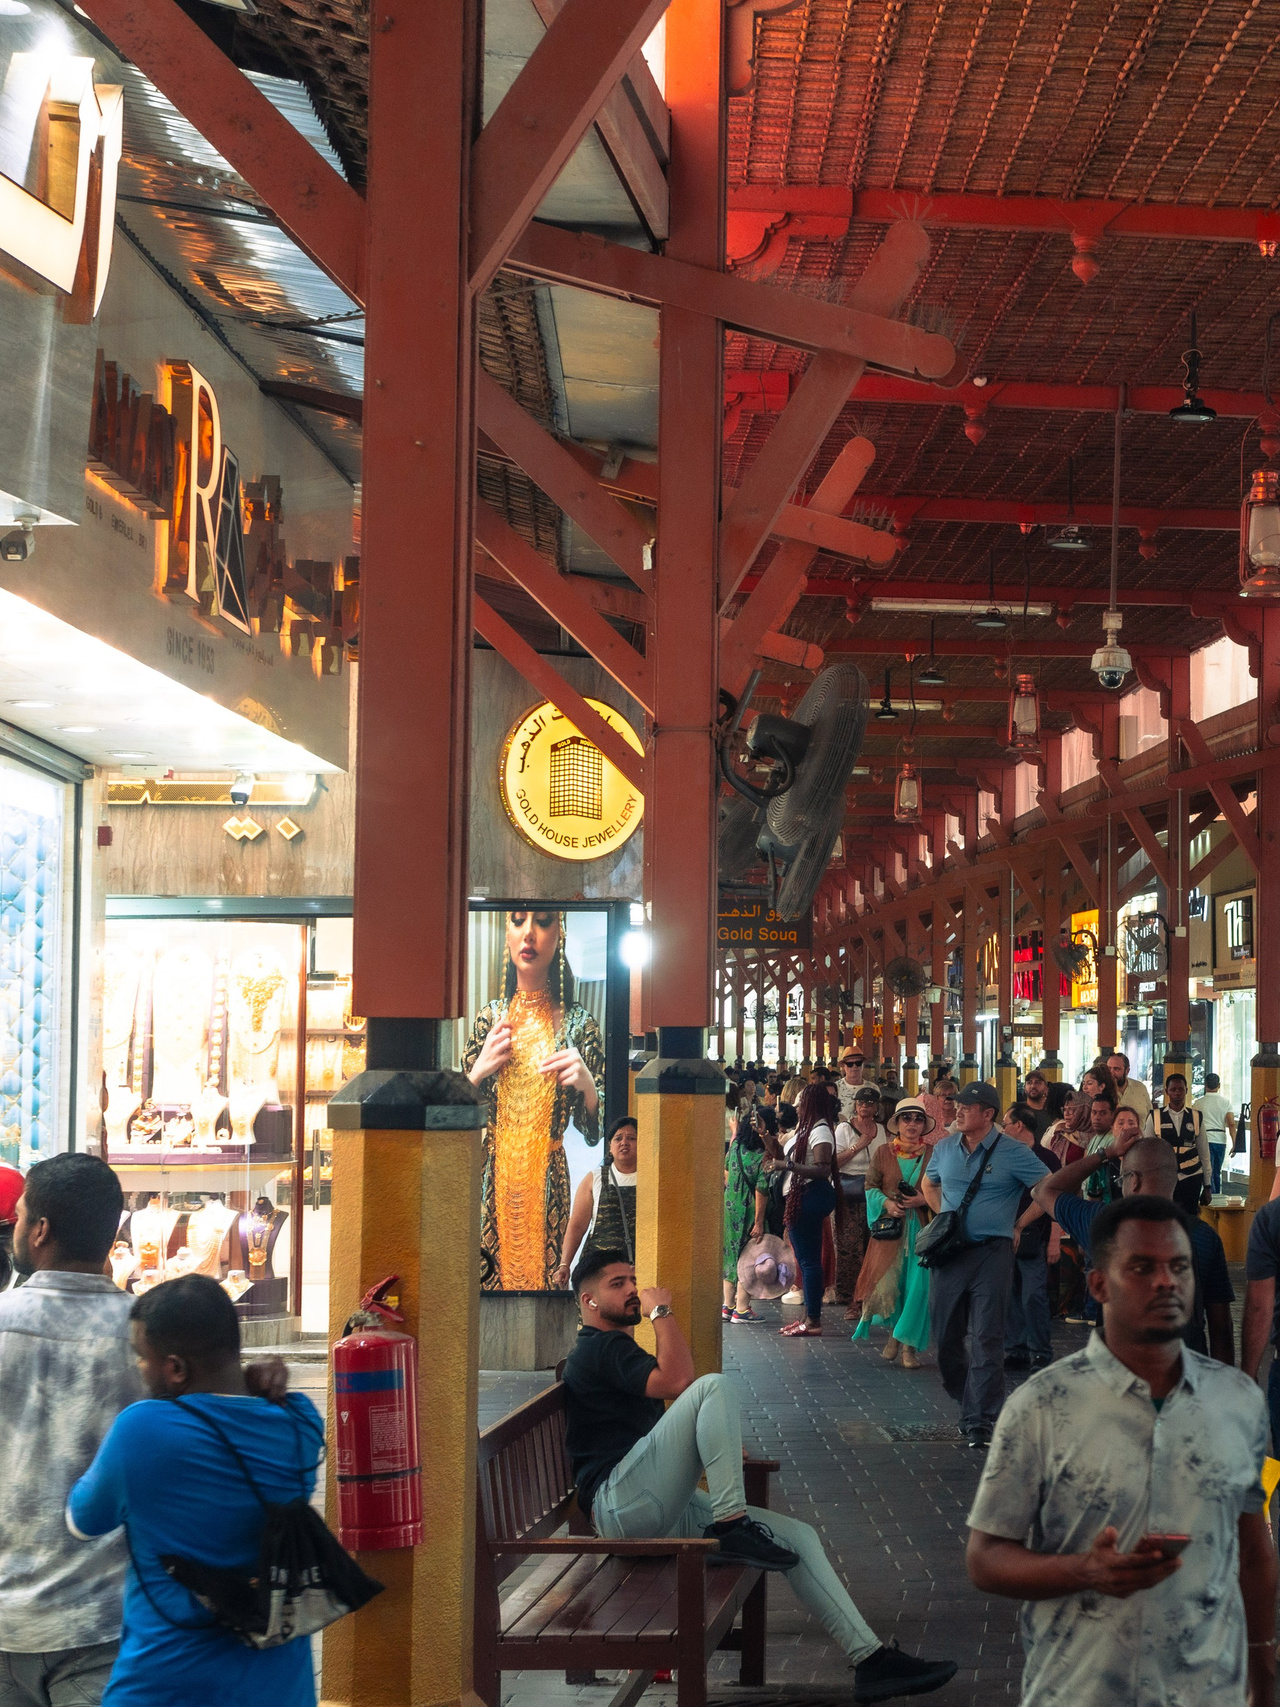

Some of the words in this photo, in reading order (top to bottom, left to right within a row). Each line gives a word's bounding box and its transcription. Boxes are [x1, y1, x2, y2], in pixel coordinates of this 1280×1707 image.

[166, 626, 194, 665] SINCE
[516, 788, 539, 826] GOLD
[537, 822, 579, 849] HOUSE
[582, 794, 637, 849] JEWELLERY
[717, 926, 753, 941] Gold
[758, 927, 798, 944] Souq
